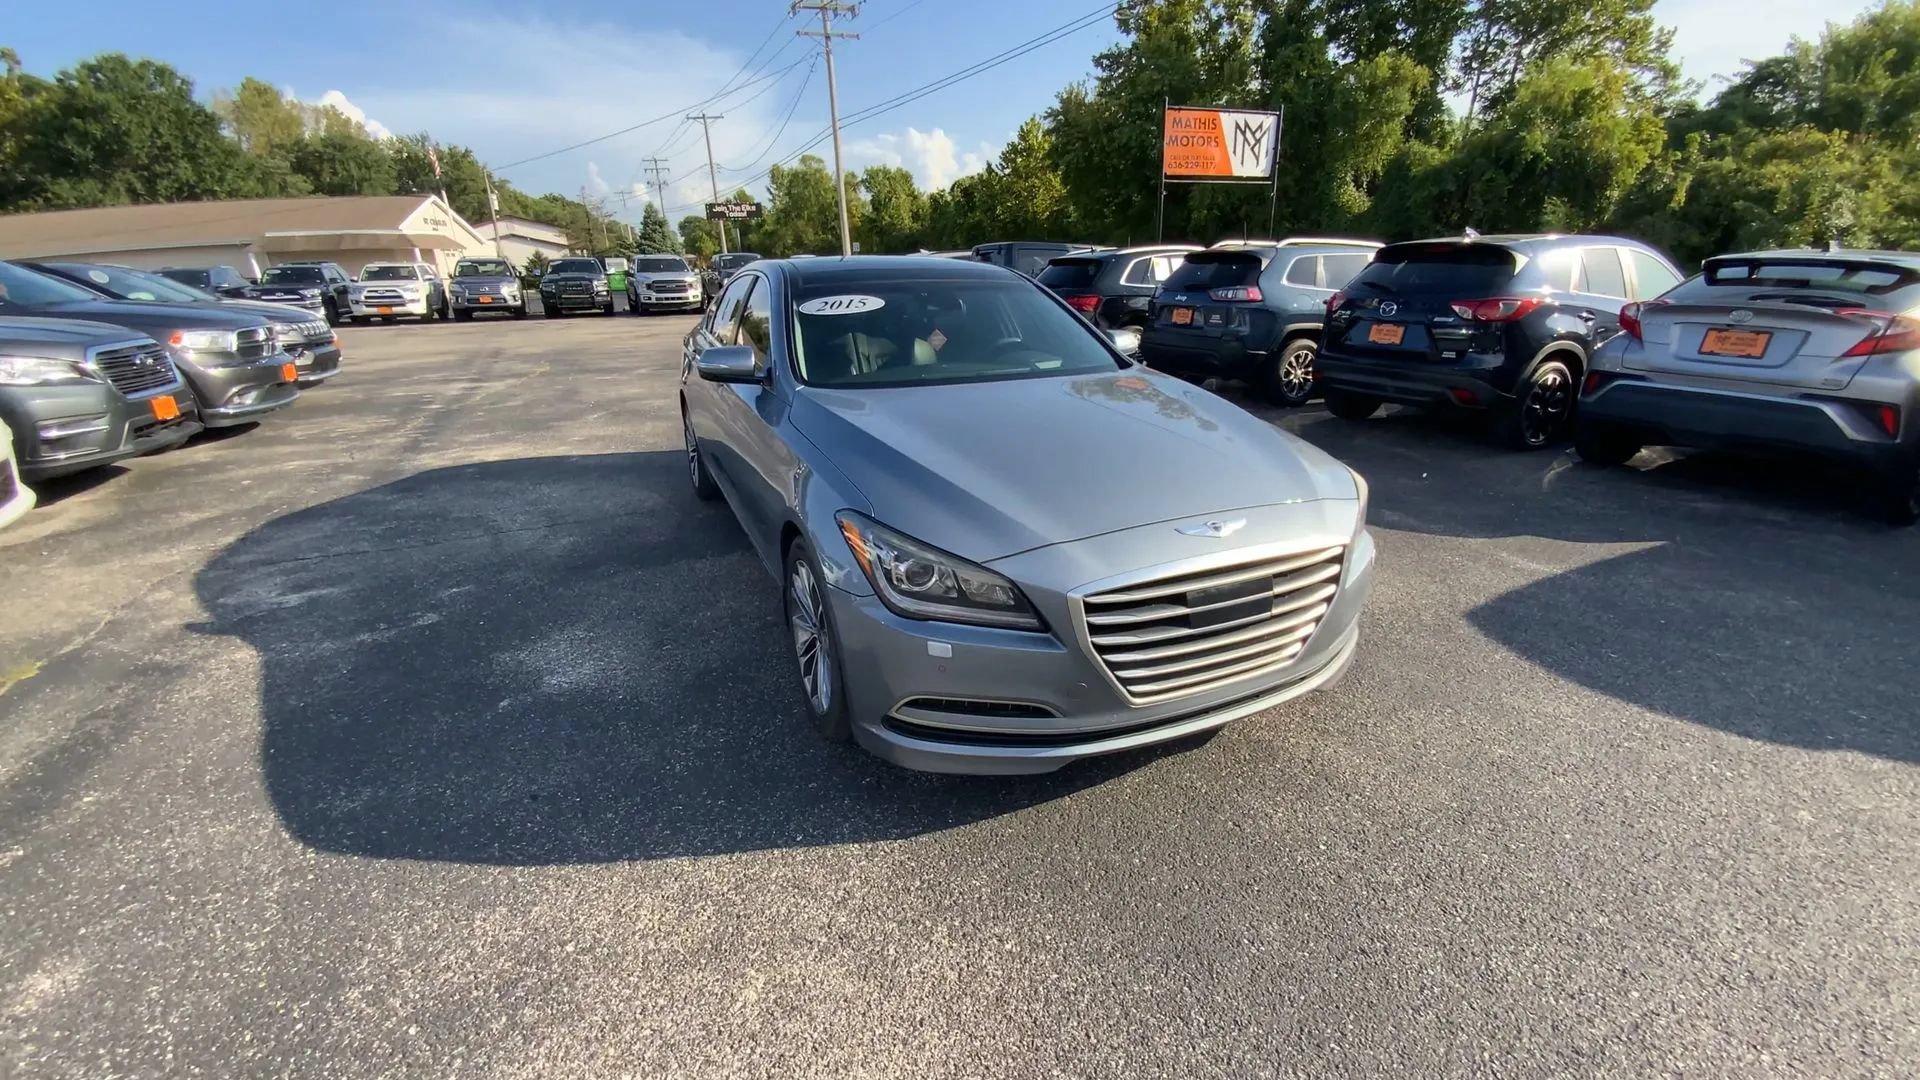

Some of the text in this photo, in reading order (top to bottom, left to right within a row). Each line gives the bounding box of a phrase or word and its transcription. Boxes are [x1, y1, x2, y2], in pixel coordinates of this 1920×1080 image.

[1171, 117, 1217, 130] MATHIS
[1166, 135, 1219, 148] MOTORS
[712, 204, 727, 212] Join
[728, 204, 741, 212] The
[816, 298, 869, 312] 2015
